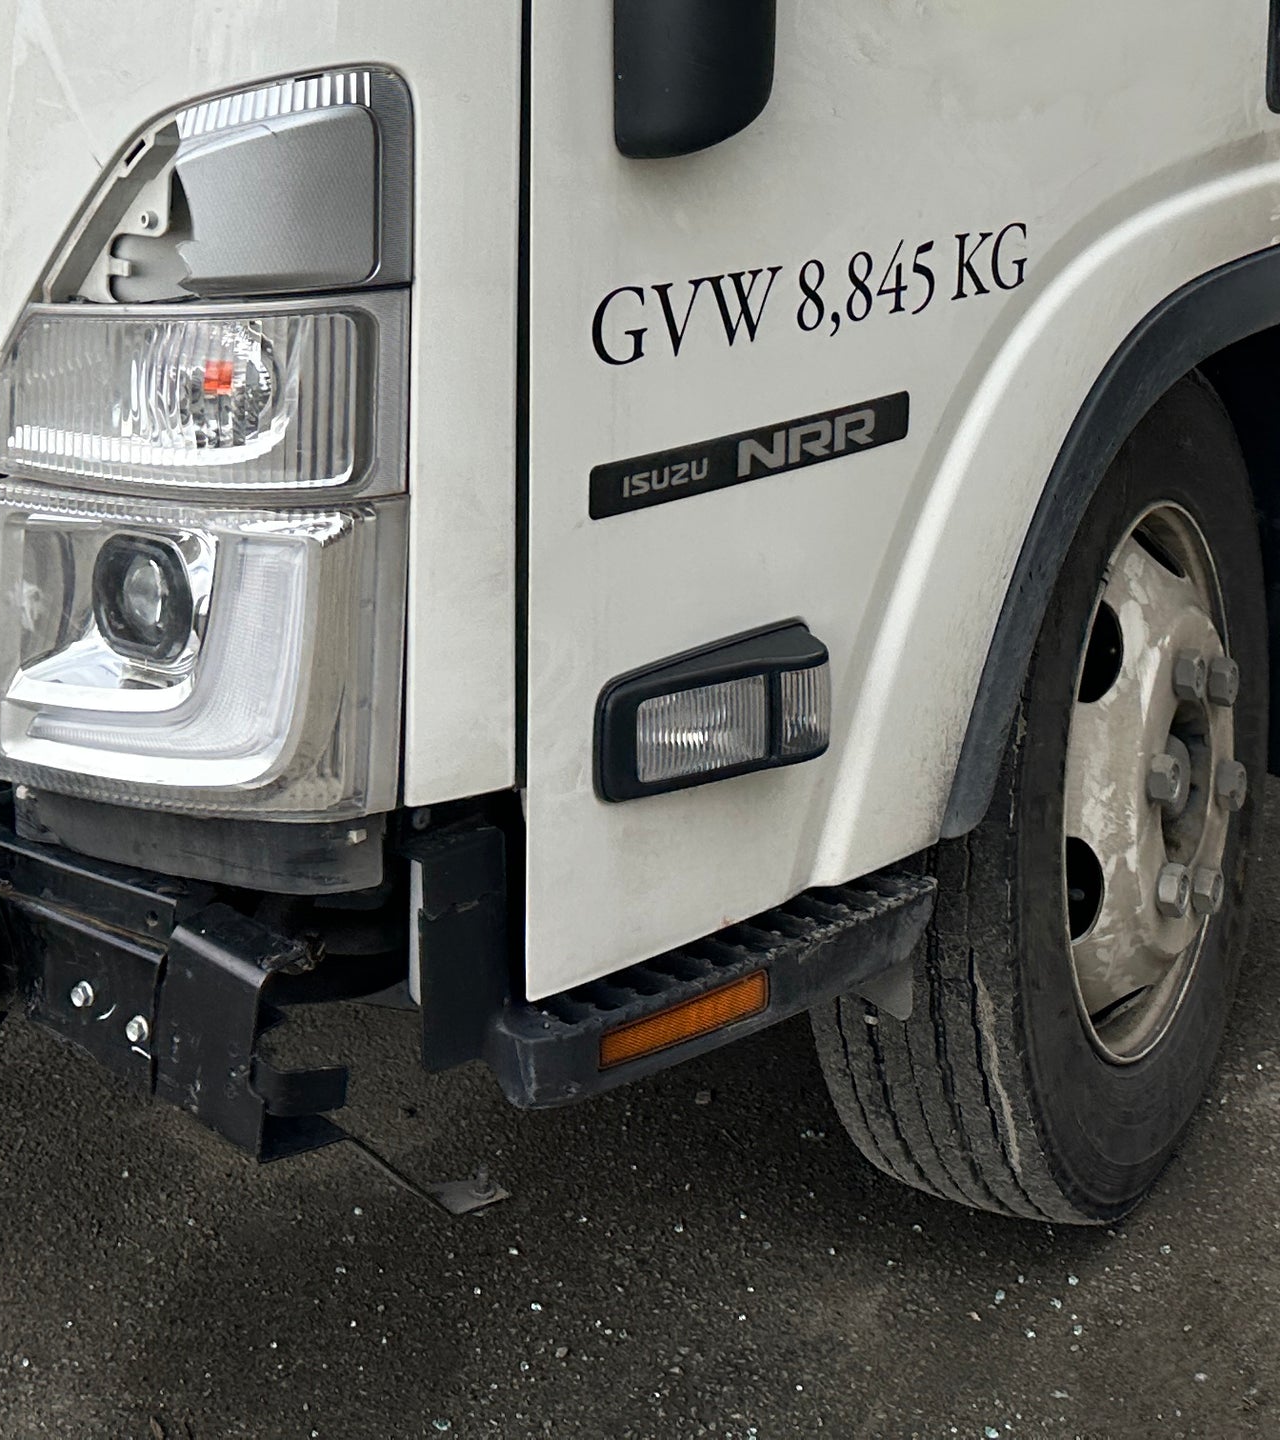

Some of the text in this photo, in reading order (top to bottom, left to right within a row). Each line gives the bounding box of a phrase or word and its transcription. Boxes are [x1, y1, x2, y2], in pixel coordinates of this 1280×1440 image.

[591, 222, 1028, 365] GVW 8,845 KG
[623, 408, 876, 499] ISUZU NRR
